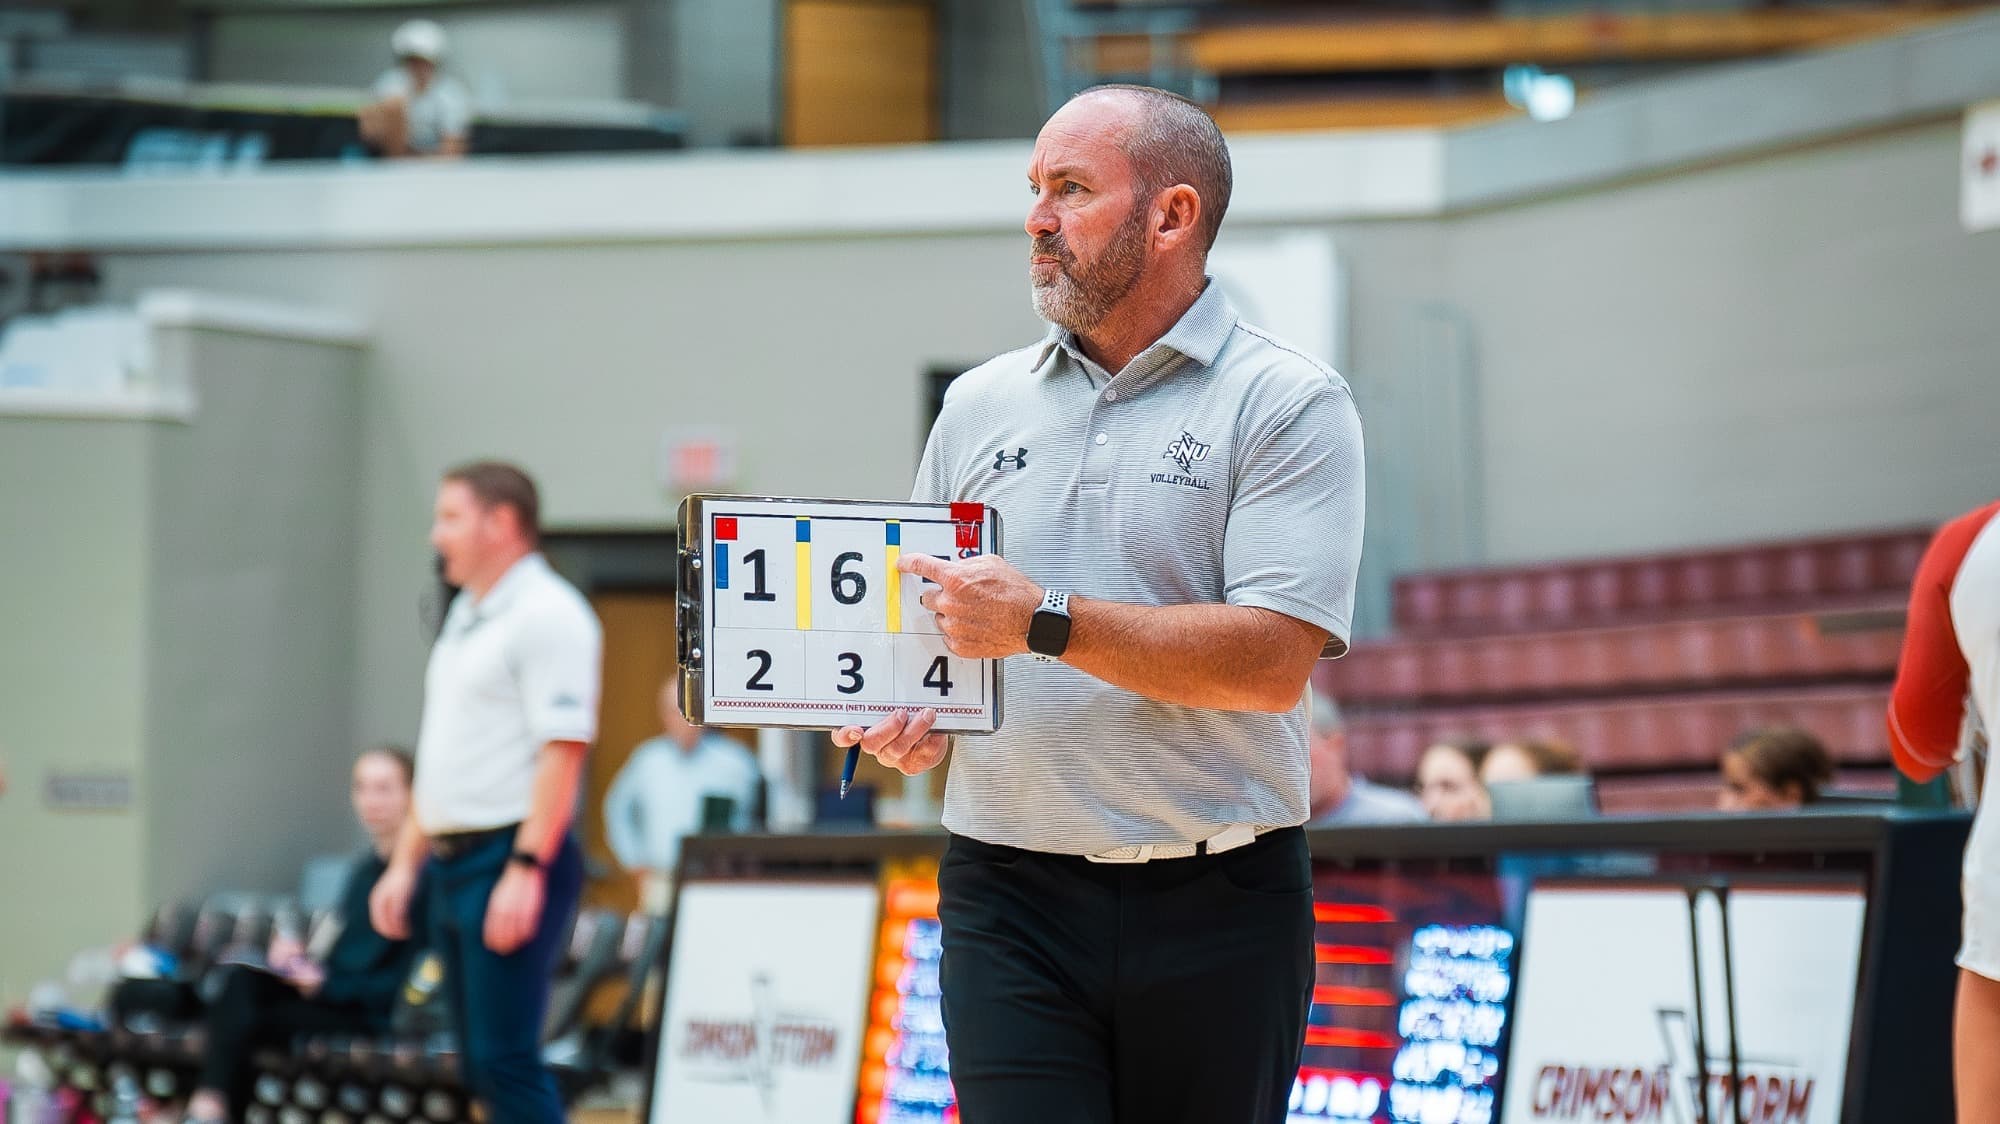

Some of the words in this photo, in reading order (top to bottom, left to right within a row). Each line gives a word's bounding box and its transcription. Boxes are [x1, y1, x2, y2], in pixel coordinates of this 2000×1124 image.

[1163, 434, 1211, 467] SNU
[1151, 473, 1210, 490] VOLLEYBALL
[743, 549, 776, 602] 1
[831, 551, 867, 605] 6
[746, 649, 774, 691] 2
[837, 652, 865, 694] 3
[922, 655, 954, 696] 4
[845, 704, 866, 712] (NET)
[1532, 1064, 1671, 1121] CRIMSON
[1694, 1072, 1815, 1124] TORM
